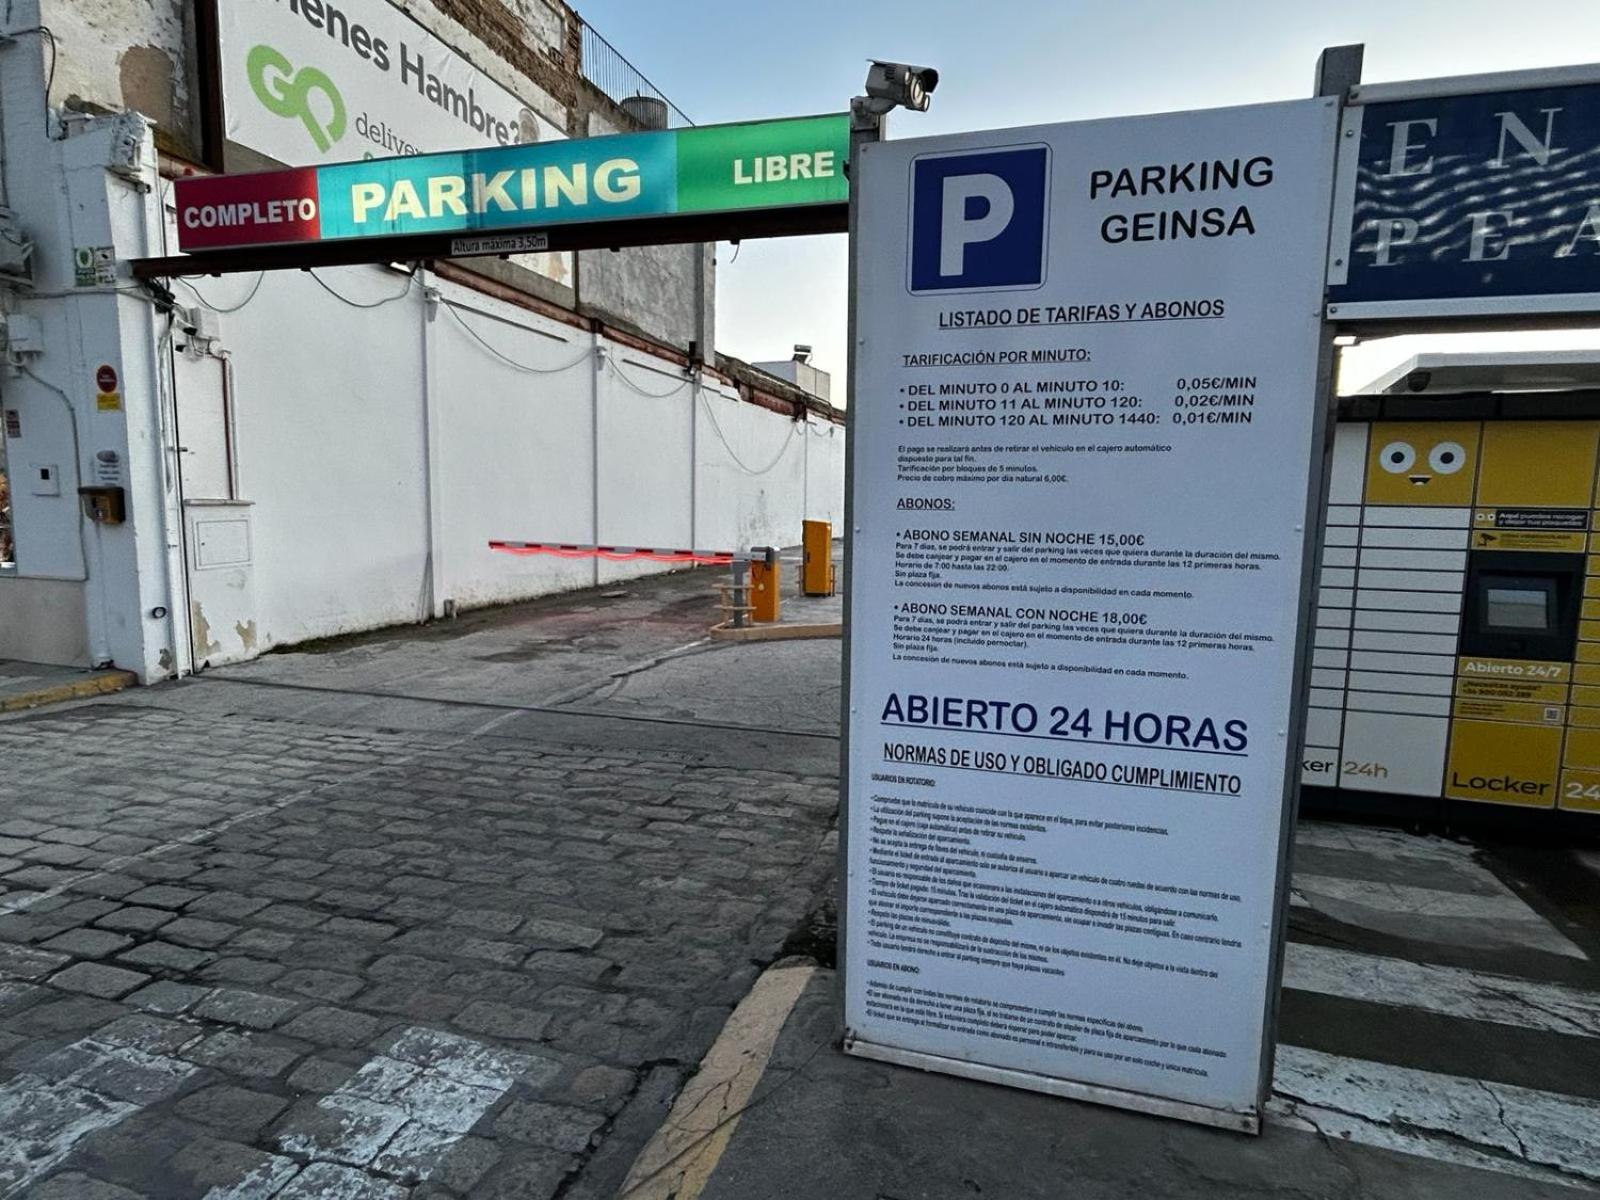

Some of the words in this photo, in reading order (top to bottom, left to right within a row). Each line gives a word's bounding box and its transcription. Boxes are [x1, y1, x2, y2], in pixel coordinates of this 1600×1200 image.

[734, 151, 835, 185] LIBRE
[1090, 156, 1274, 200] PARKING
[352, 158, 640, 224] PARKING
[184, 198, 316, 229] COMPLETO
[939, 173, 1015, 277] P
[1100, 206, 1256, 244] GEINSA
[453, 241, 480, 253] Altura
[482, 238, 516, 251] máxima
[517, 236, 546, 250] 3,50m
[939, 309, 1012, 328] LISTADO
[1016, 308, 1040, 325] DE
[1045, 304, 1120, 324] TARIFAS
[1125, 303, 1136, 321] Y
[1140, 299, 1224, 320] ABONOS
[903, 351, 995, 367] TARIFICACIÓN
[998, 351, 1027, 364] POR
[1031, 348, 1090, 362] MINUTO:
[908, 384, 936, 395] DEL
[939, 383, 997, 394] MINUTO
[1000, 382, 1009, 393] 0
[1012, 382, 1031, 393] AL
[1036, 380, 1098, 392] MINUTO
[1102, 380, 1124, 391] 10:
[1176, 377, 1256, 391] 0,05€/MIN
[907, 400, 935, 410] DEL
[938, 399, 996, 410] MINUTO
[1001, 399, 1016, 409] 11
[1020, 398, 1039, 408] AL
[1044, 397, 1106, 408] MINUTO
[1111, 397, 1142, 407] 120:
[1174, 394, 1254, 408] 0,02€/MIN
[907, 416, 935, 426] DEL
[938, 415, 995, 426] MINUTO
[1000, 415, 1025, 425] 120
[1028, 414, 1047, 425] AL
[1052, 413, 1114, 425] MINUTO
[1119, 413, 1160, 424] 1440:
[1172, 411, 1252, 426] 0,01€/MIN
[1096, 445, 1123, 453] cajero
[896, 498, 956, 511] ABONOS:
[903, 530, 950, 540] ABONO
[952, 530, 1015, 542] SEMANAL
[1019, 532, 1041, 543] SIN
[1045, 532, 1095, 544] NOCHE
[1099, 534, 1144, 546] 15,00€
[1034, 547, 1065, 555] parking
[1122, 549, 1149, 557] quiera
[1150, 549, 1183, 557] durante
[1194, 550, 1233, 558] duración
[900, 603, 947, 614] ABONO
[949, 605, 1012, 617] SEMANAL
[1015, 608, 1045, 619] CON
[1048, 609, 1098, 622] NOCHE
[1103, 612, 1147, 625] 18,00€
[1465, 662, 1524, 675] Abierto
[1527, 665, 1562, 678] 24/7
[881, 692, 1038, 735] ABIERTO
[1049, 705, 1091, 737] 24
[1104, 709, 1247, 751] HORAS
[883, 743, 946, 767] NORMAS
[949, 749, 970, 769] DE
[974, 751, 1006, 773] USO
[1010, 754, 1020, 774] Y
[1023, 755, 1107, 782] OBLIGADO
[1111, 764, 1241, 795] CUMPLIMIENTO
[1343, 761, 1388, 779] 24h
[1452, 772, 1550, 796] Locker
